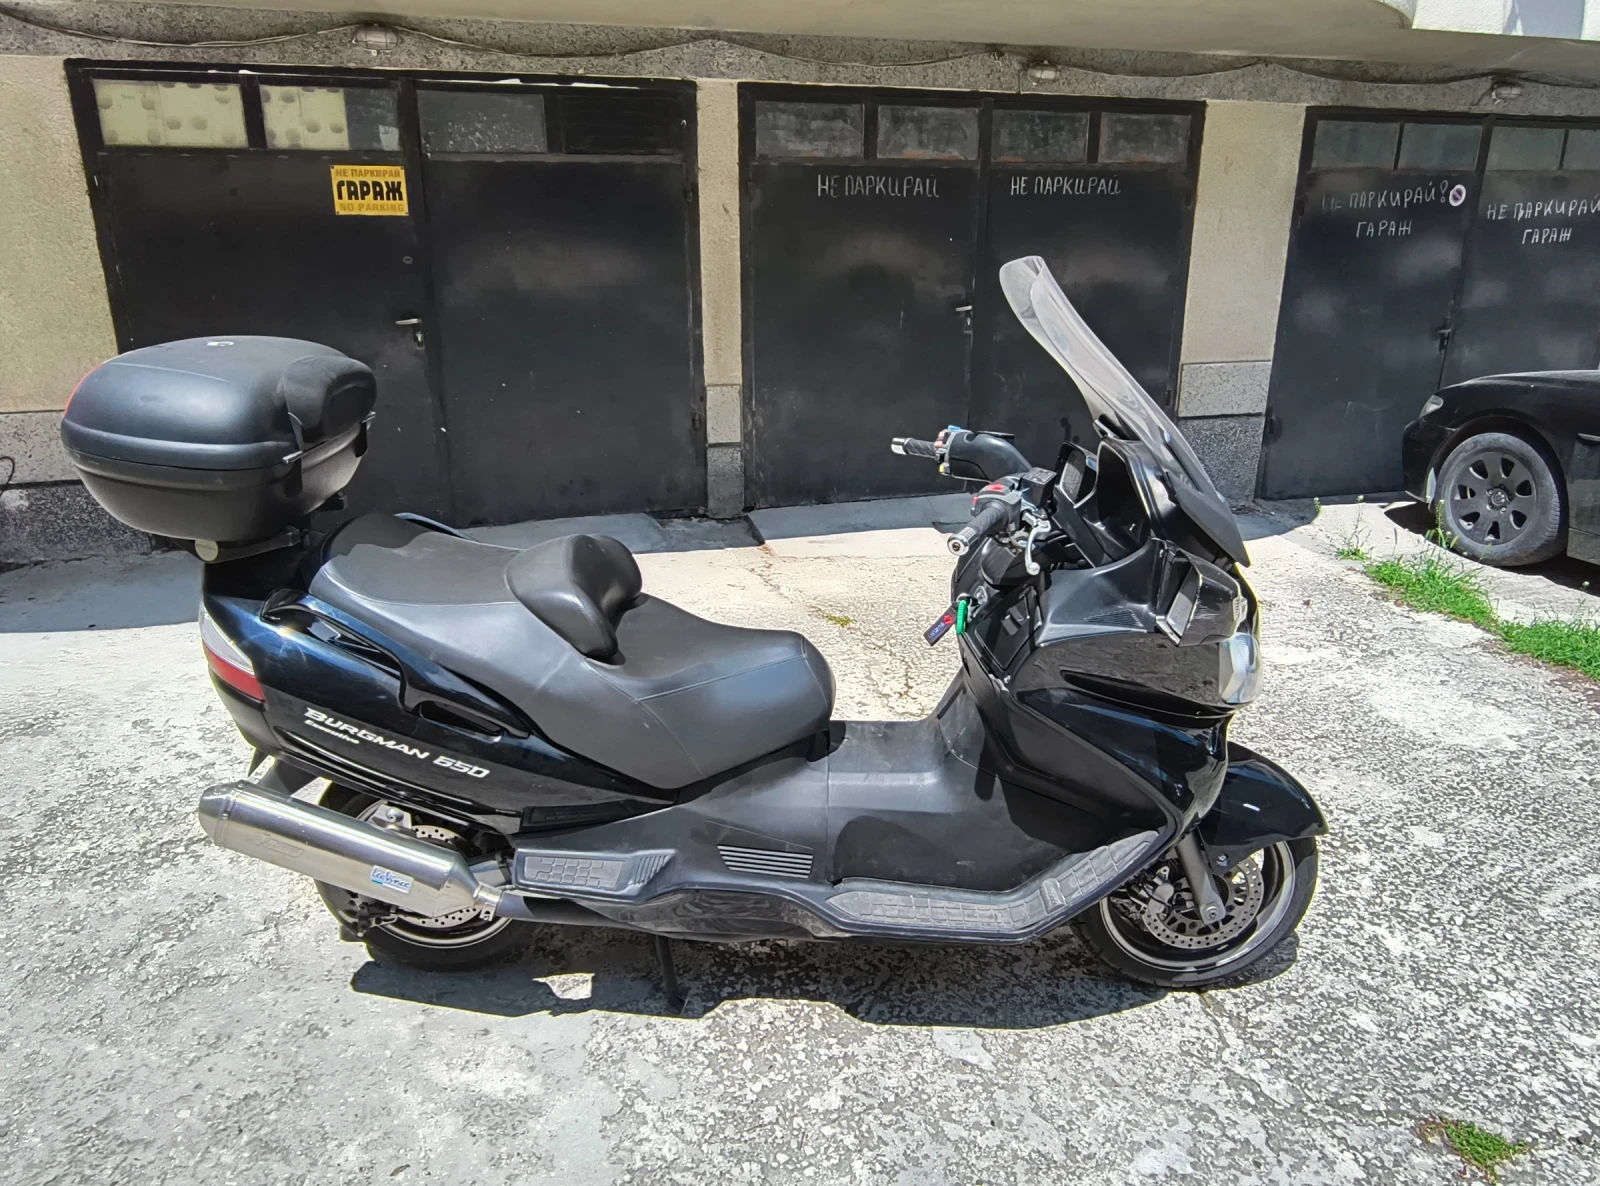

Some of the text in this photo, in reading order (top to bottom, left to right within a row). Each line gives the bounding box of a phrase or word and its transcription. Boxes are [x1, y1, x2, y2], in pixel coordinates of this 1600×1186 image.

[335, 168, 400, 178] НЕ ПАРКИРАЙ
[336, 180, 404, 201] ГАРАЖ
[817, 173, 940, 198] НЕ ПАРКИРАЙ
[1010, 174, 1121, 196] НЕ ПАРКИРАЙ
[339, 203, 405, 212] NO PARKING
[1487, 193, 1600, 221] НЕ ПАРКИРАЙ
[1355, 219, 1413, 238] ГАРАЖ
[1521, 227, 1573, 245] ГАРАЖ
[303, 706, 491, 779] BURGMAN 650
